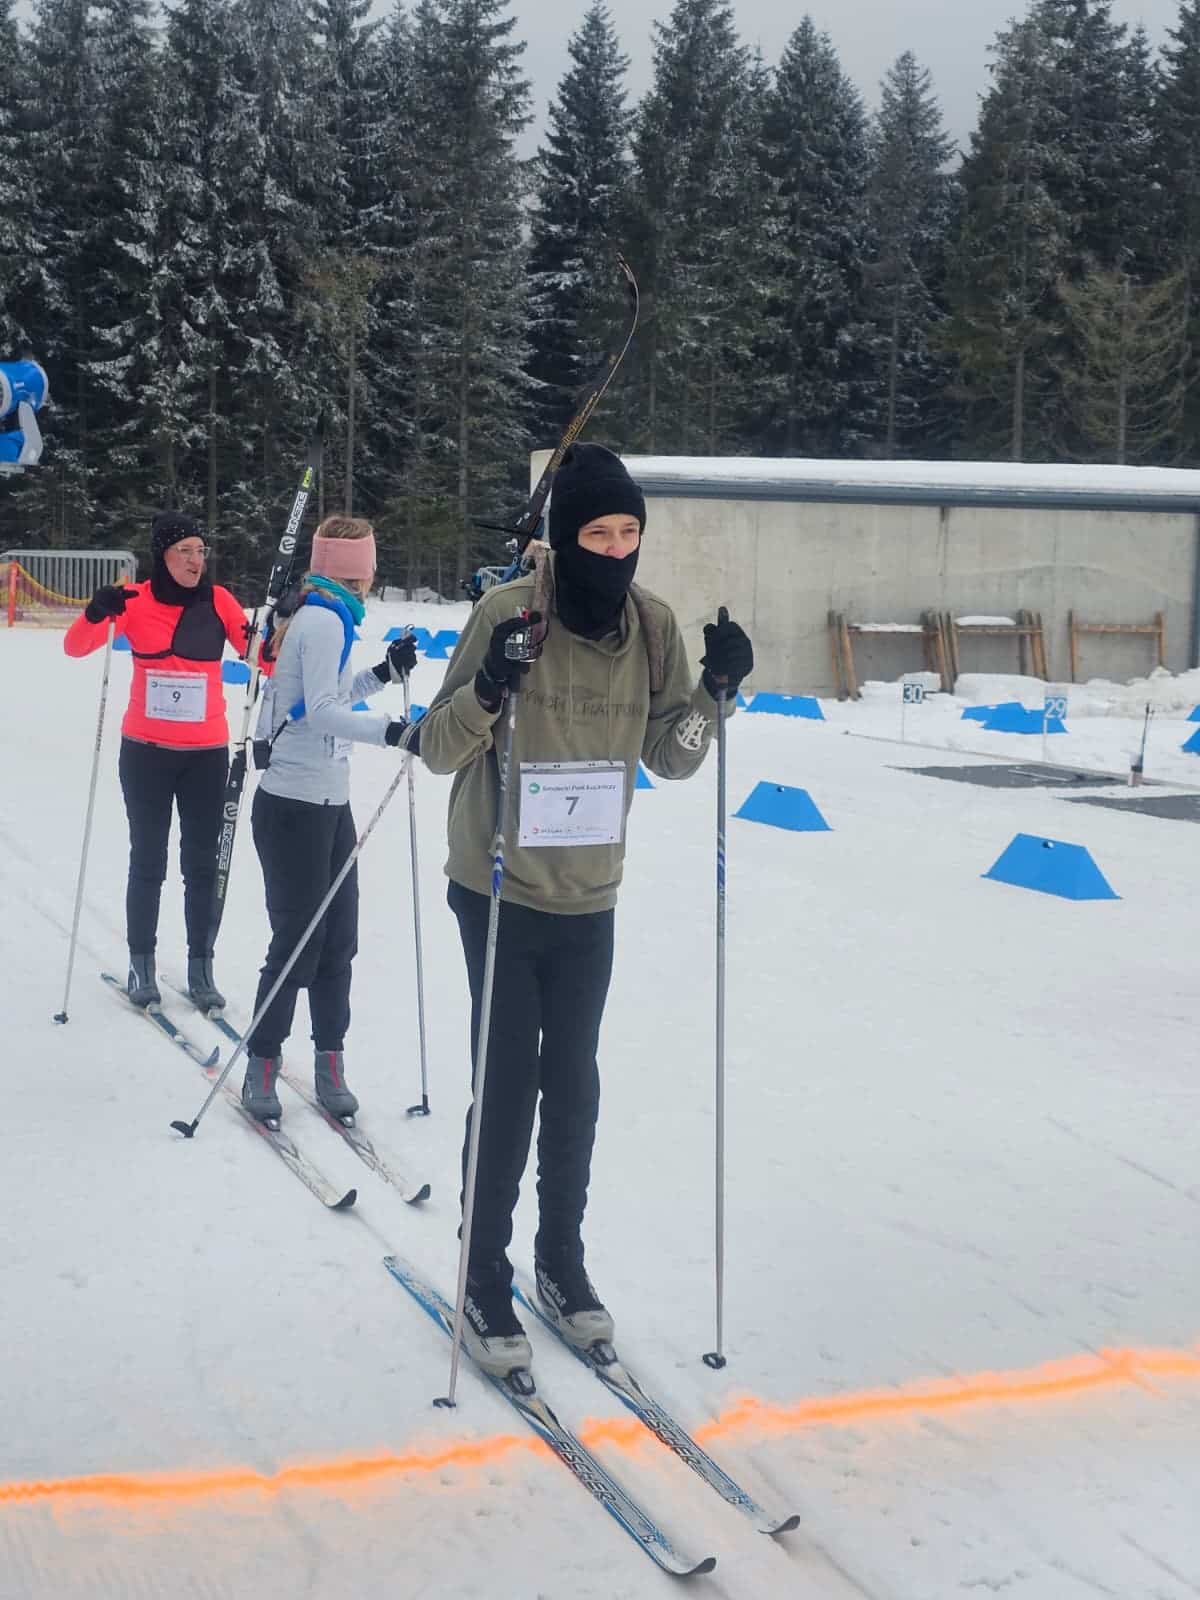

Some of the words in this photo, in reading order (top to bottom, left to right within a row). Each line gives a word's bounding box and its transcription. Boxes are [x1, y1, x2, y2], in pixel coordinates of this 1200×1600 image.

[172, 691, 181, 703] 9
[903, 685, 922, 703] 30
[1045, 698, 1067, 720] 29
[565, 796, 580, 816] 7
[642, 1408, 702, 1467] FISCHER
[552, 1439, 617, 1502] FISCHER
